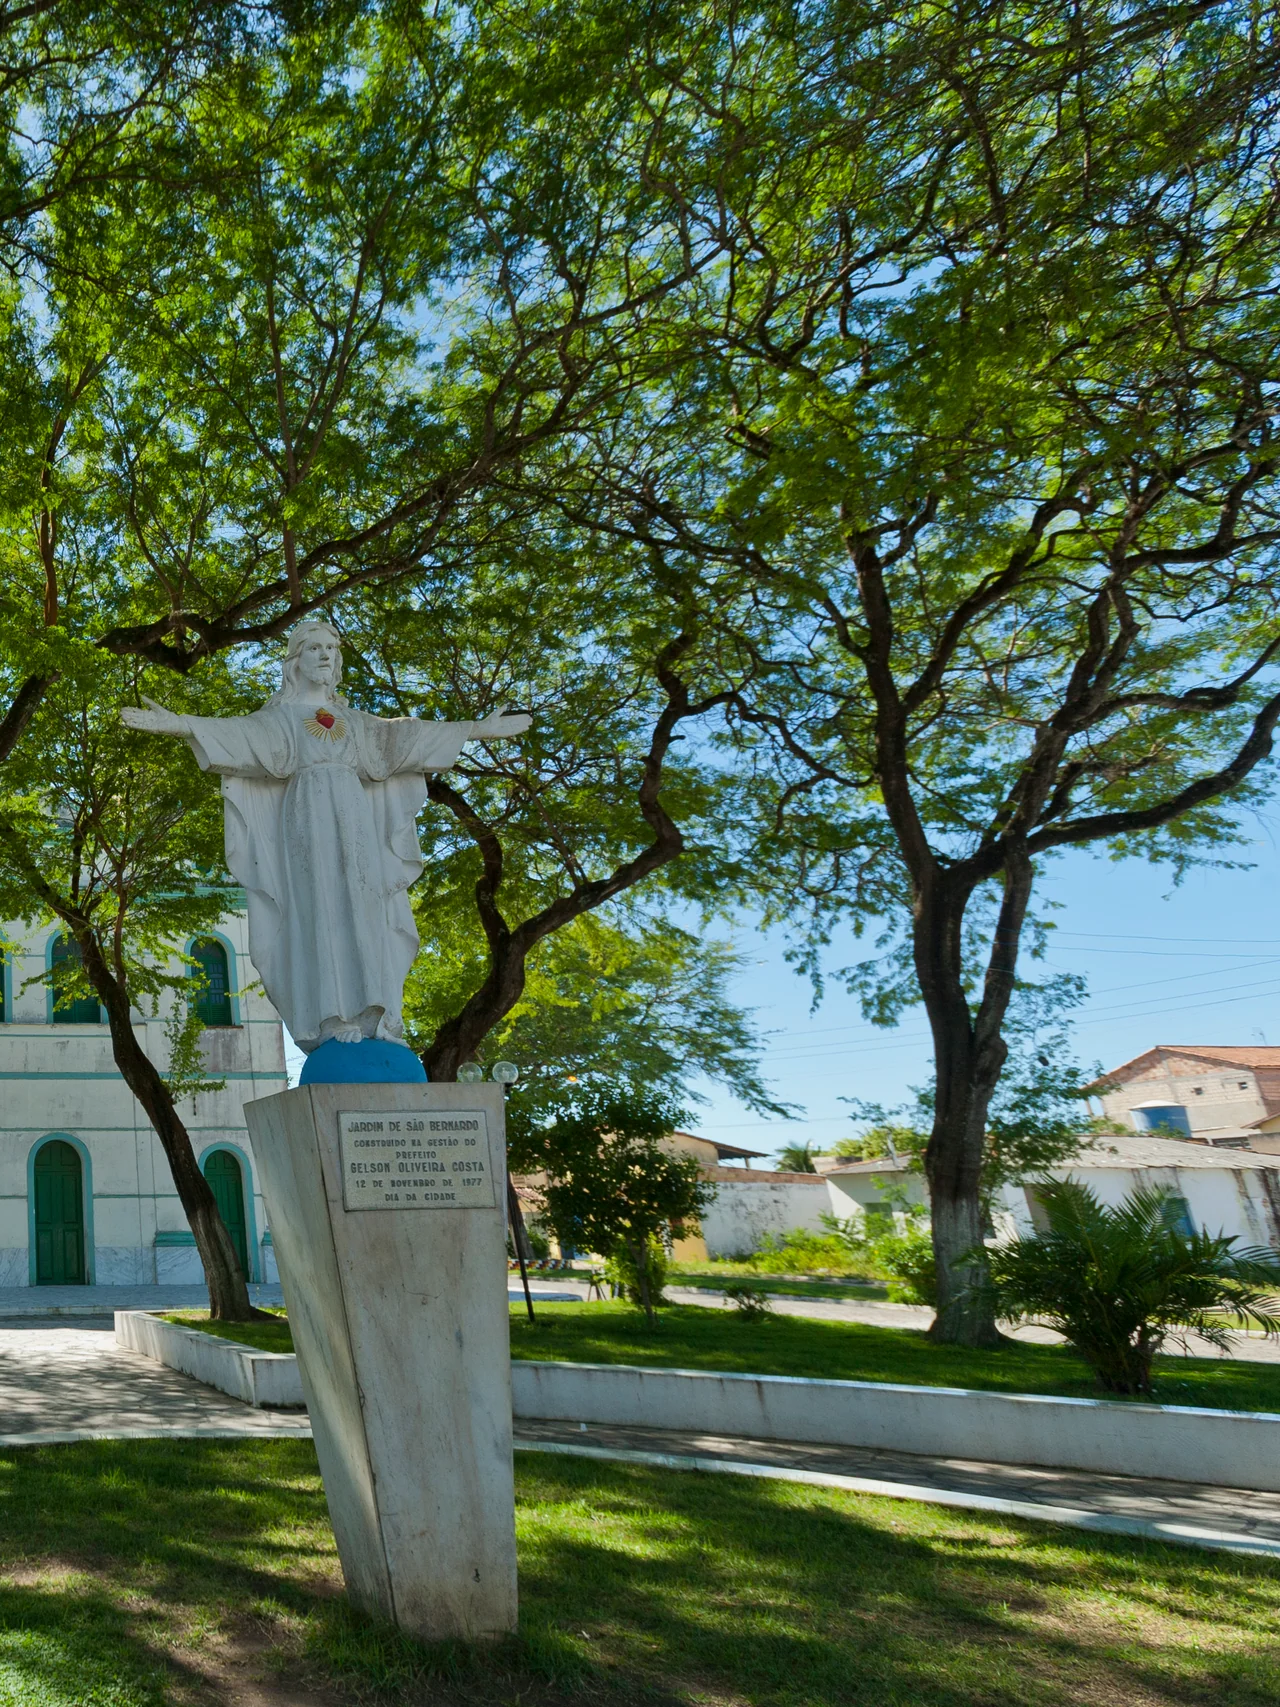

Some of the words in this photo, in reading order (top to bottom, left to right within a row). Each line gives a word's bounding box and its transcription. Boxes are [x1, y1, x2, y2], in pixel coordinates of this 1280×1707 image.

[348, 1121, 384, 1132] JARDIM
[388, 1121, 401, 1132] DE
[406, 1118, 424, 1131] SÃO
[430, 1120, 479, 1131] BERNARDO
[411, 1138, 422, 1147] NA
[427, 1136, 459, 1147] GESTÃO
[464, 1138, 476, 1146] DO
[396, 1151, 437, 1159] PREFEITO
[350, 1162, 390, 1174] GELSON
[398, 1162, 446, 1173] OLIVEIRA
[452, 1161, 485, 1172] COSTA
[356, 1180, 366, 1188] 12
[372, 1179, 384, 1188] DE
[442, 1178, 454, 1187] DE
[462, 1178, 482, 1186] 1977
[384, 1194, 399, 1202] DIA
[406, 1193, 417, 1201] DA
[424, 1192, 456, 1201] CIDADE
